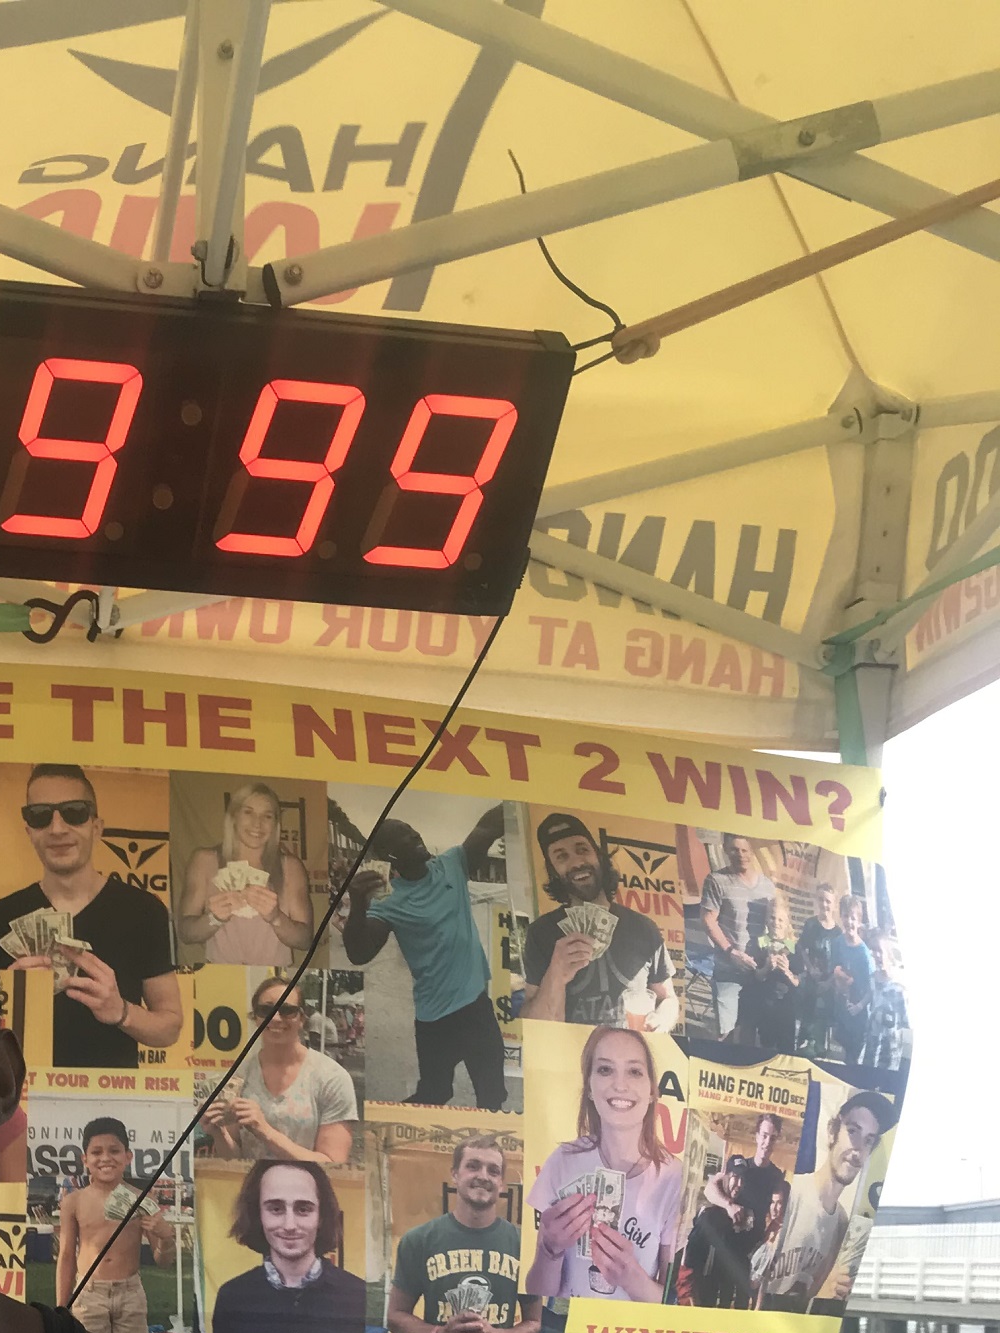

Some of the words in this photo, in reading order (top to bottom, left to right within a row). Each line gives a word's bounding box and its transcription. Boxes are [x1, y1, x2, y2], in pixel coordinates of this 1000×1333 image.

[51, 684, 256, 752] THE
[291, 703, 542, 782] NEXT
[574, 742, 626, 796] 2
[646, 751, 853, 832] WIN?
[108, 871, 168, 892] ANG
[618, 875, 676, 894] HANG
[148, 1050, 167, 1064] BAR
[46, 1072, 89, 1089] YOUR
[98, 1075, 135, 1090] OWN
[145, 1077, 180, 1091] RISK
[698, 1069, 735, 1094] HANG
[738, 1079, 764, 1101] FOR
[768, 1086, 790, 1106] 100
[698, 1089, 721, 1102] HANG
[723, 1095, 734, 1105] AT
[735, 1097, 757, 1109] YOUR
[759, 1101, 777, 1113] OWN
[624, 1216, 652, 1249] Girl
[426, 1248, 484, 1282] GREEN
[487, 1250, 521, 1282] BAY
[437, 1300, 509, 1325] PARS
